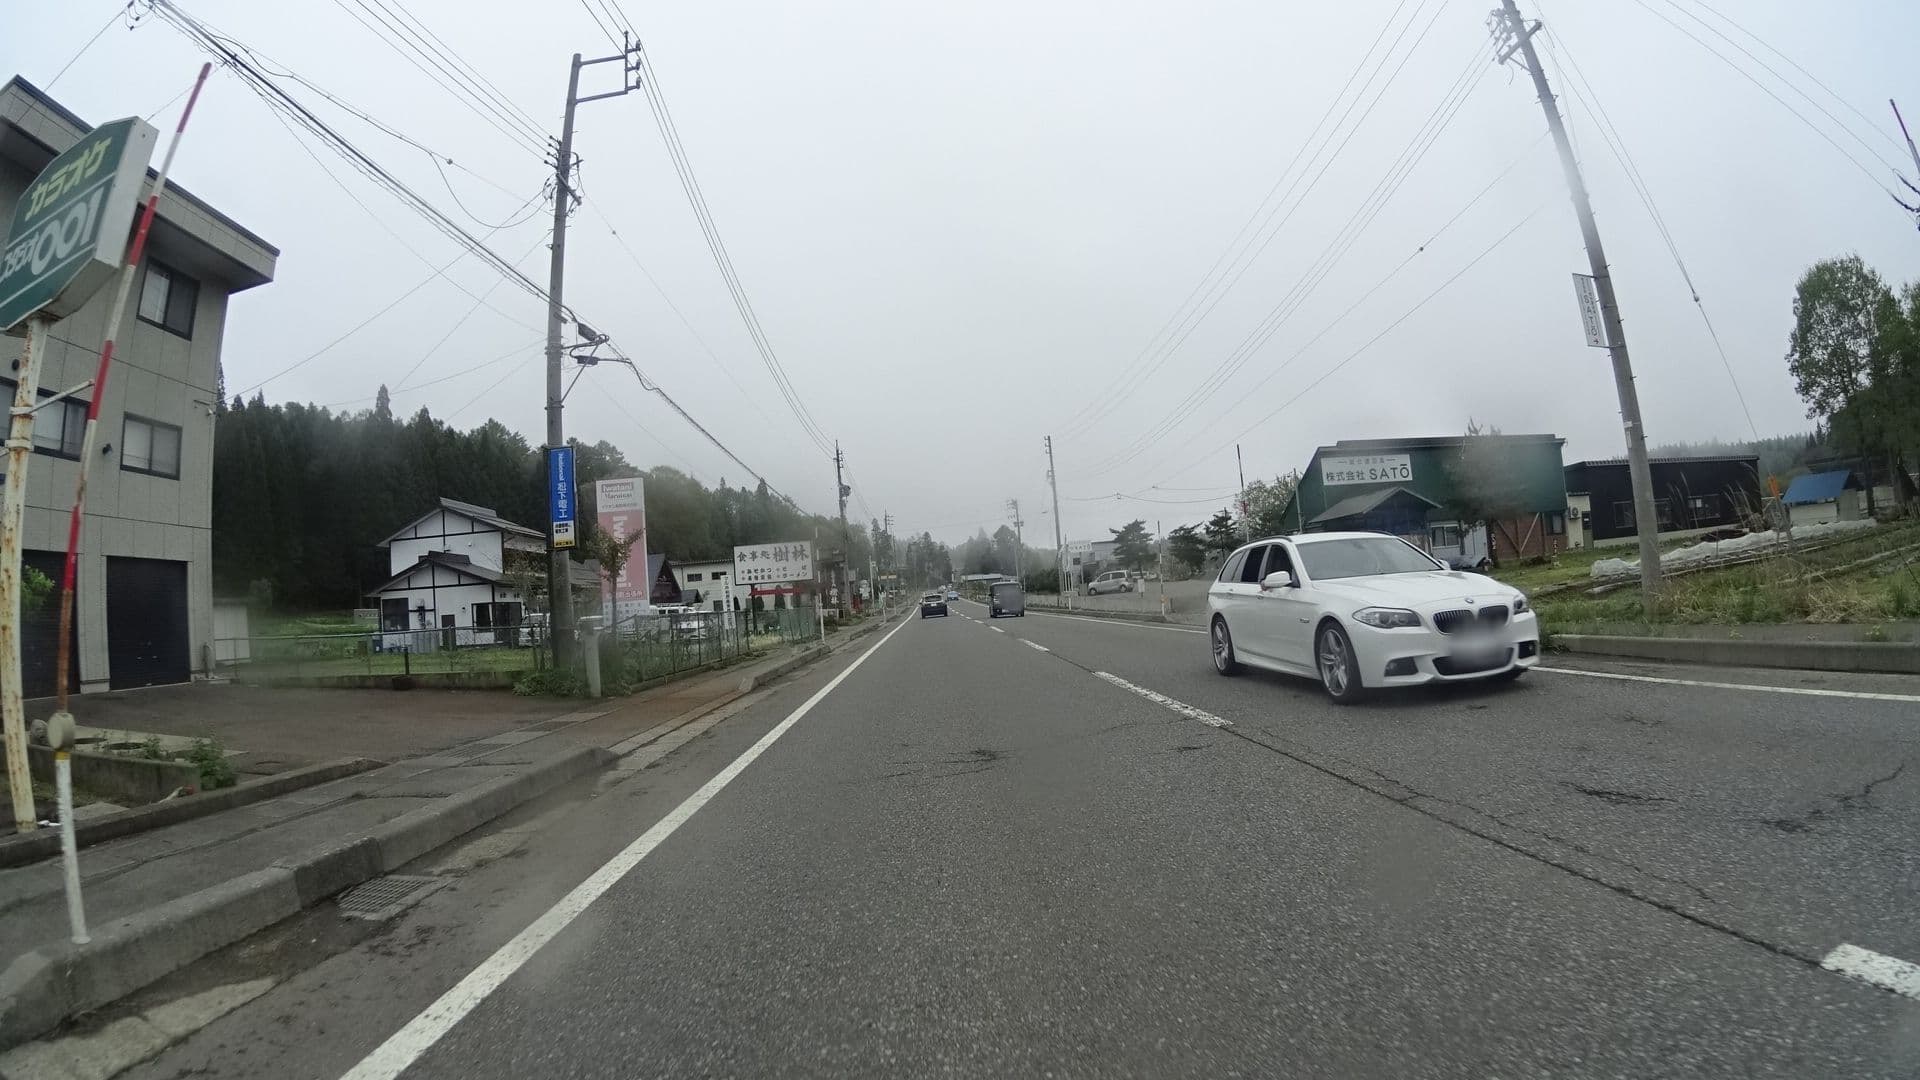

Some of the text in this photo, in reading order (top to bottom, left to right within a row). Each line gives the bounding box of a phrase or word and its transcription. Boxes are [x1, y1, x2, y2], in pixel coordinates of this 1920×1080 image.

[25, 136, 112, 222] カラオケ
[31, 187, 104, 275] 001
[1326, 469, 1366, 481] 株式会社
